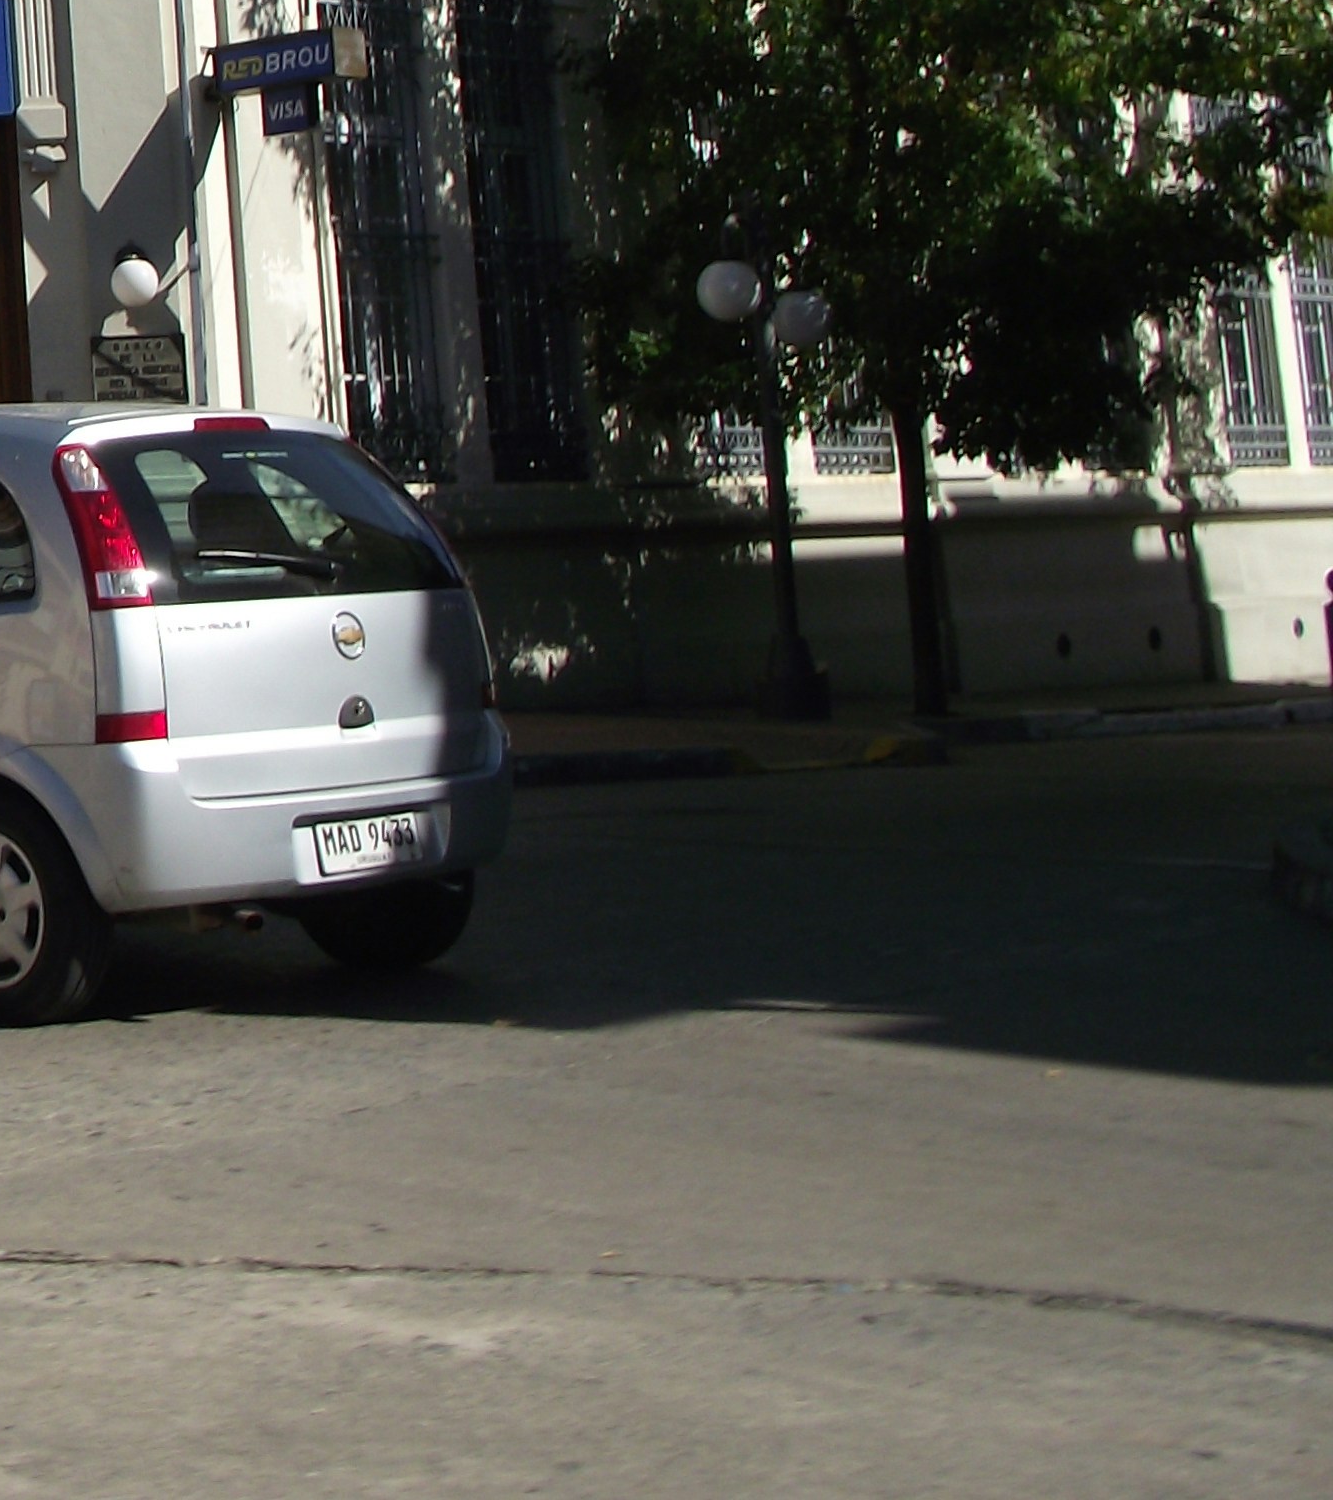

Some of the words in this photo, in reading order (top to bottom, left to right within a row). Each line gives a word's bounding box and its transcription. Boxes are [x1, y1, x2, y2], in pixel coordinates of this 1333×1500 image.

[268, 99, 304, 122] VISA
[322, 824, 362, 855] MAD
[368, 817, 414, 851] 9433
